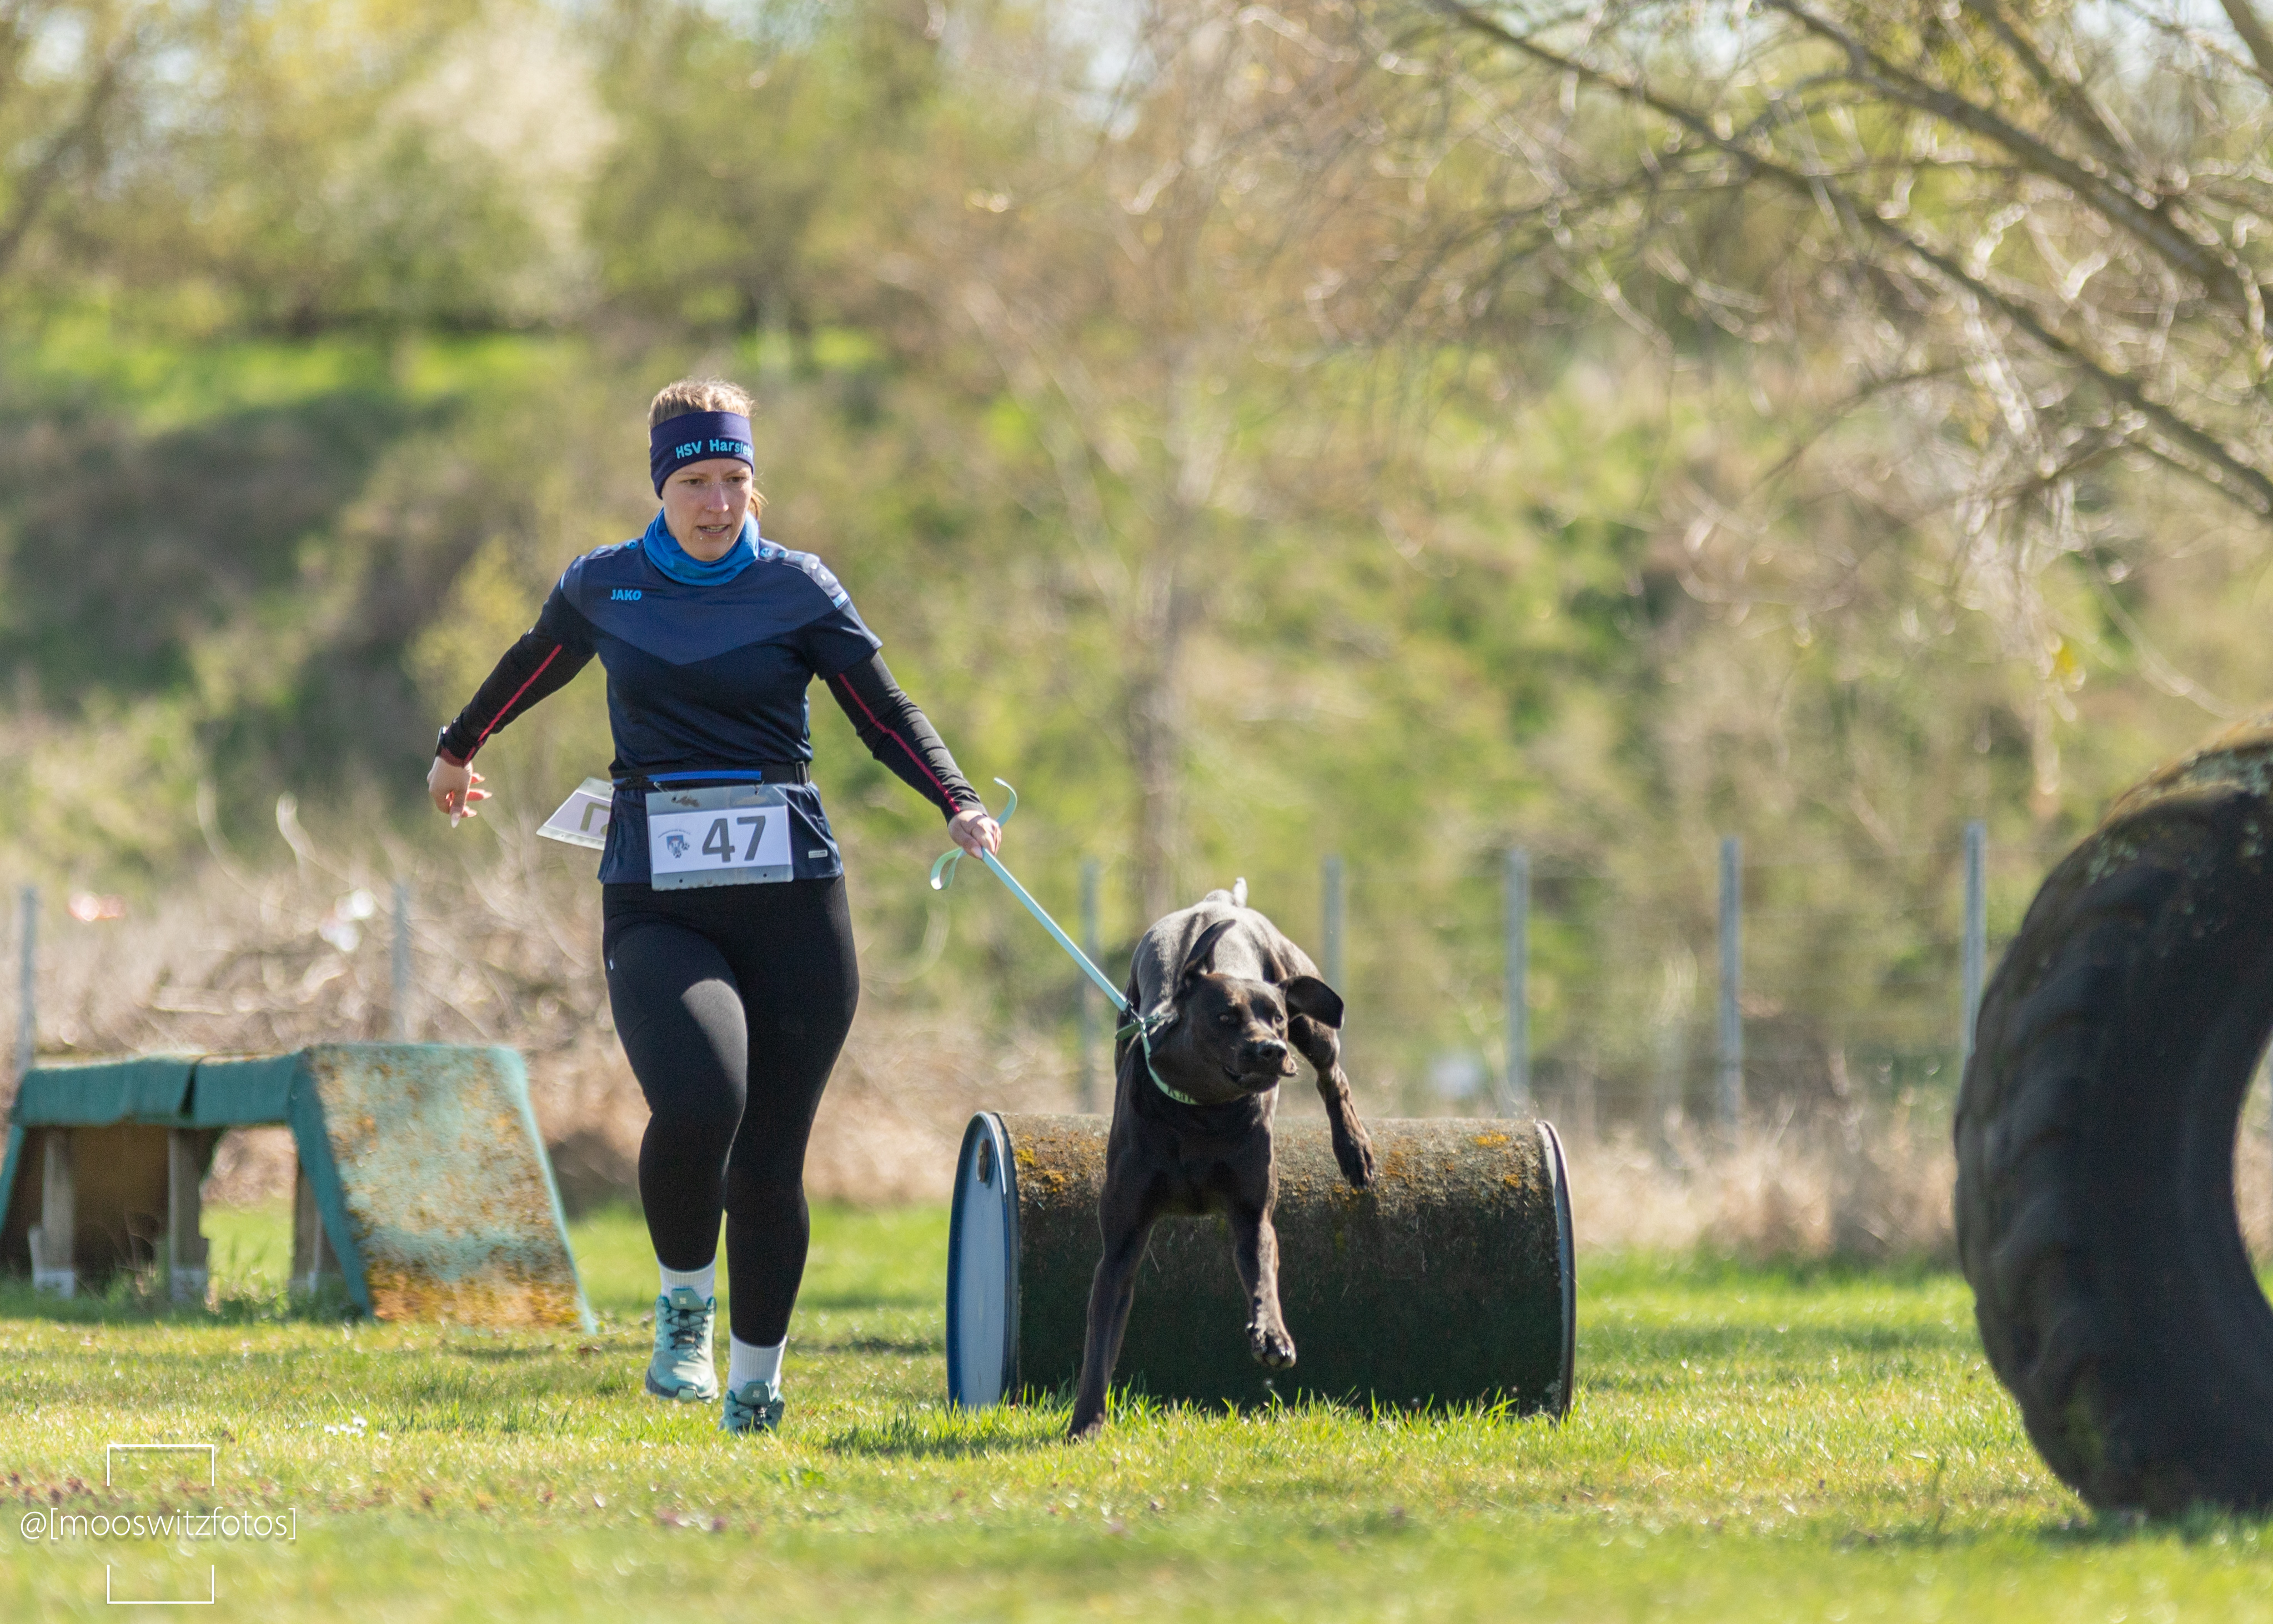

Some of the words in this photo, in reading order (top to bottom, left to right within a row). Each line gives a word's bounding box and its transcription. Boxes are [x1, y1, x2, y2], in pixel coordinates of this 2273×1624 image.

[676, 440, 702, 459] HSV
[611, 589, 642, 600] JAKO
[702, 815, 766, 863] 47
